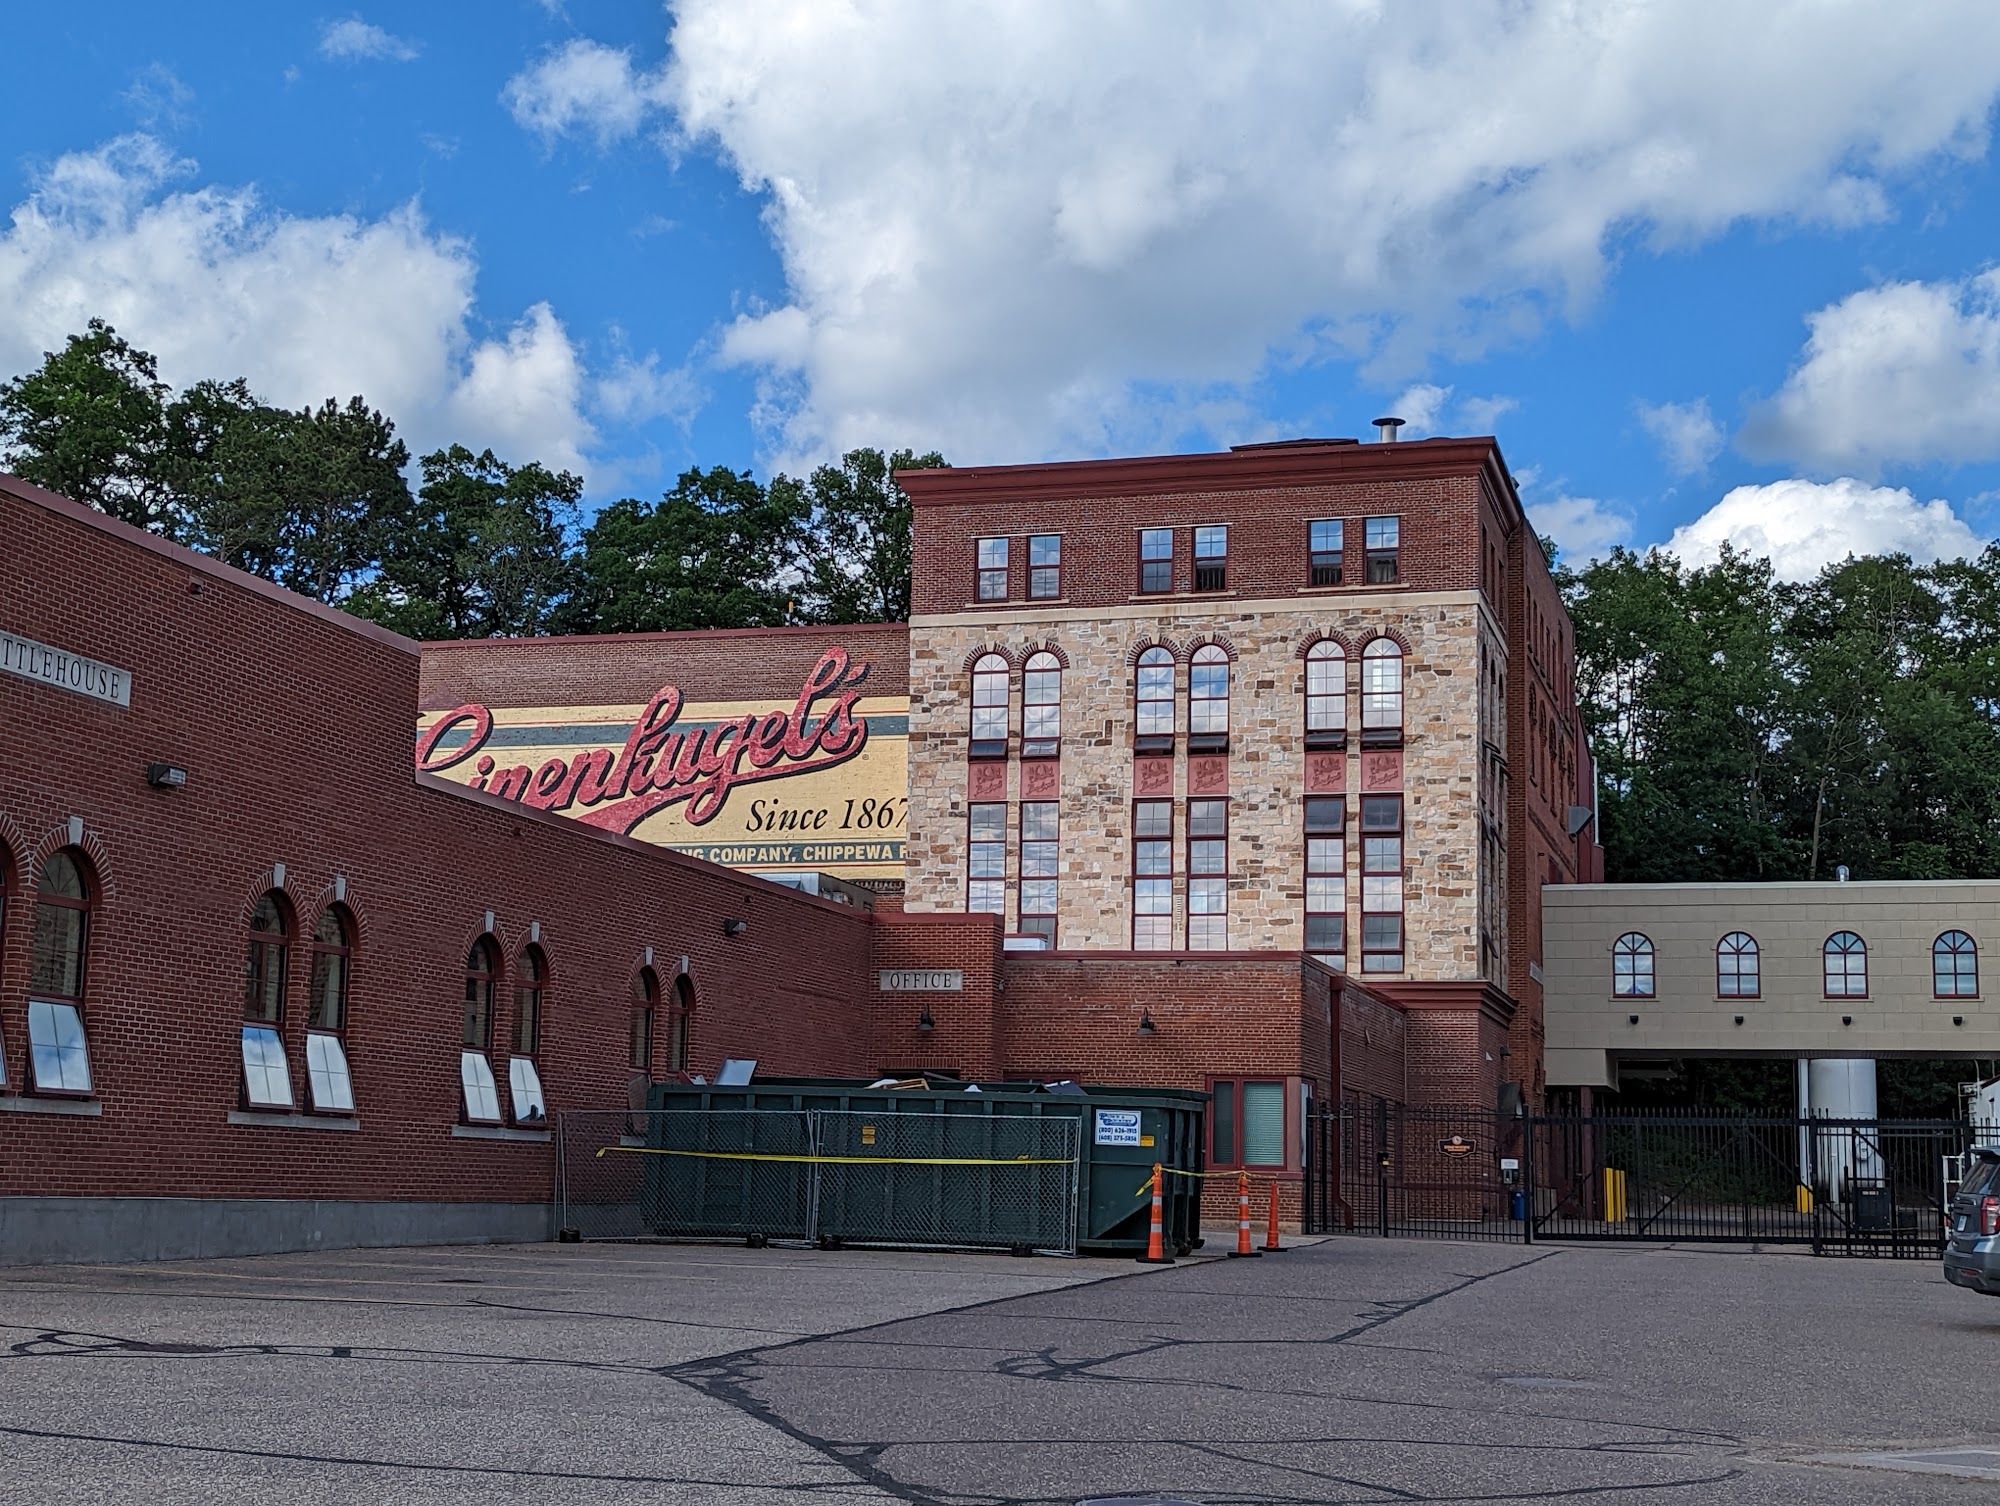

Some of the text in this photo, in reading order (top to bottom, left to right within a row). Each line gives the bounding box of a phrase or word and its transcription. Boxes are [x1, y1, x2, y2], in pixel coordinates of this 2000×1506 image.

[3, 638, 120, 699] TTLEHOUSE
[416, 645, 870, 828] inenkugel's
[745, 798, 828, 832] Since
[709, 846, 797, 863] COMPANY,
[802, 844, 893, 860] CHIPPEWA
[890, 973, 952, 988] OFFICE
